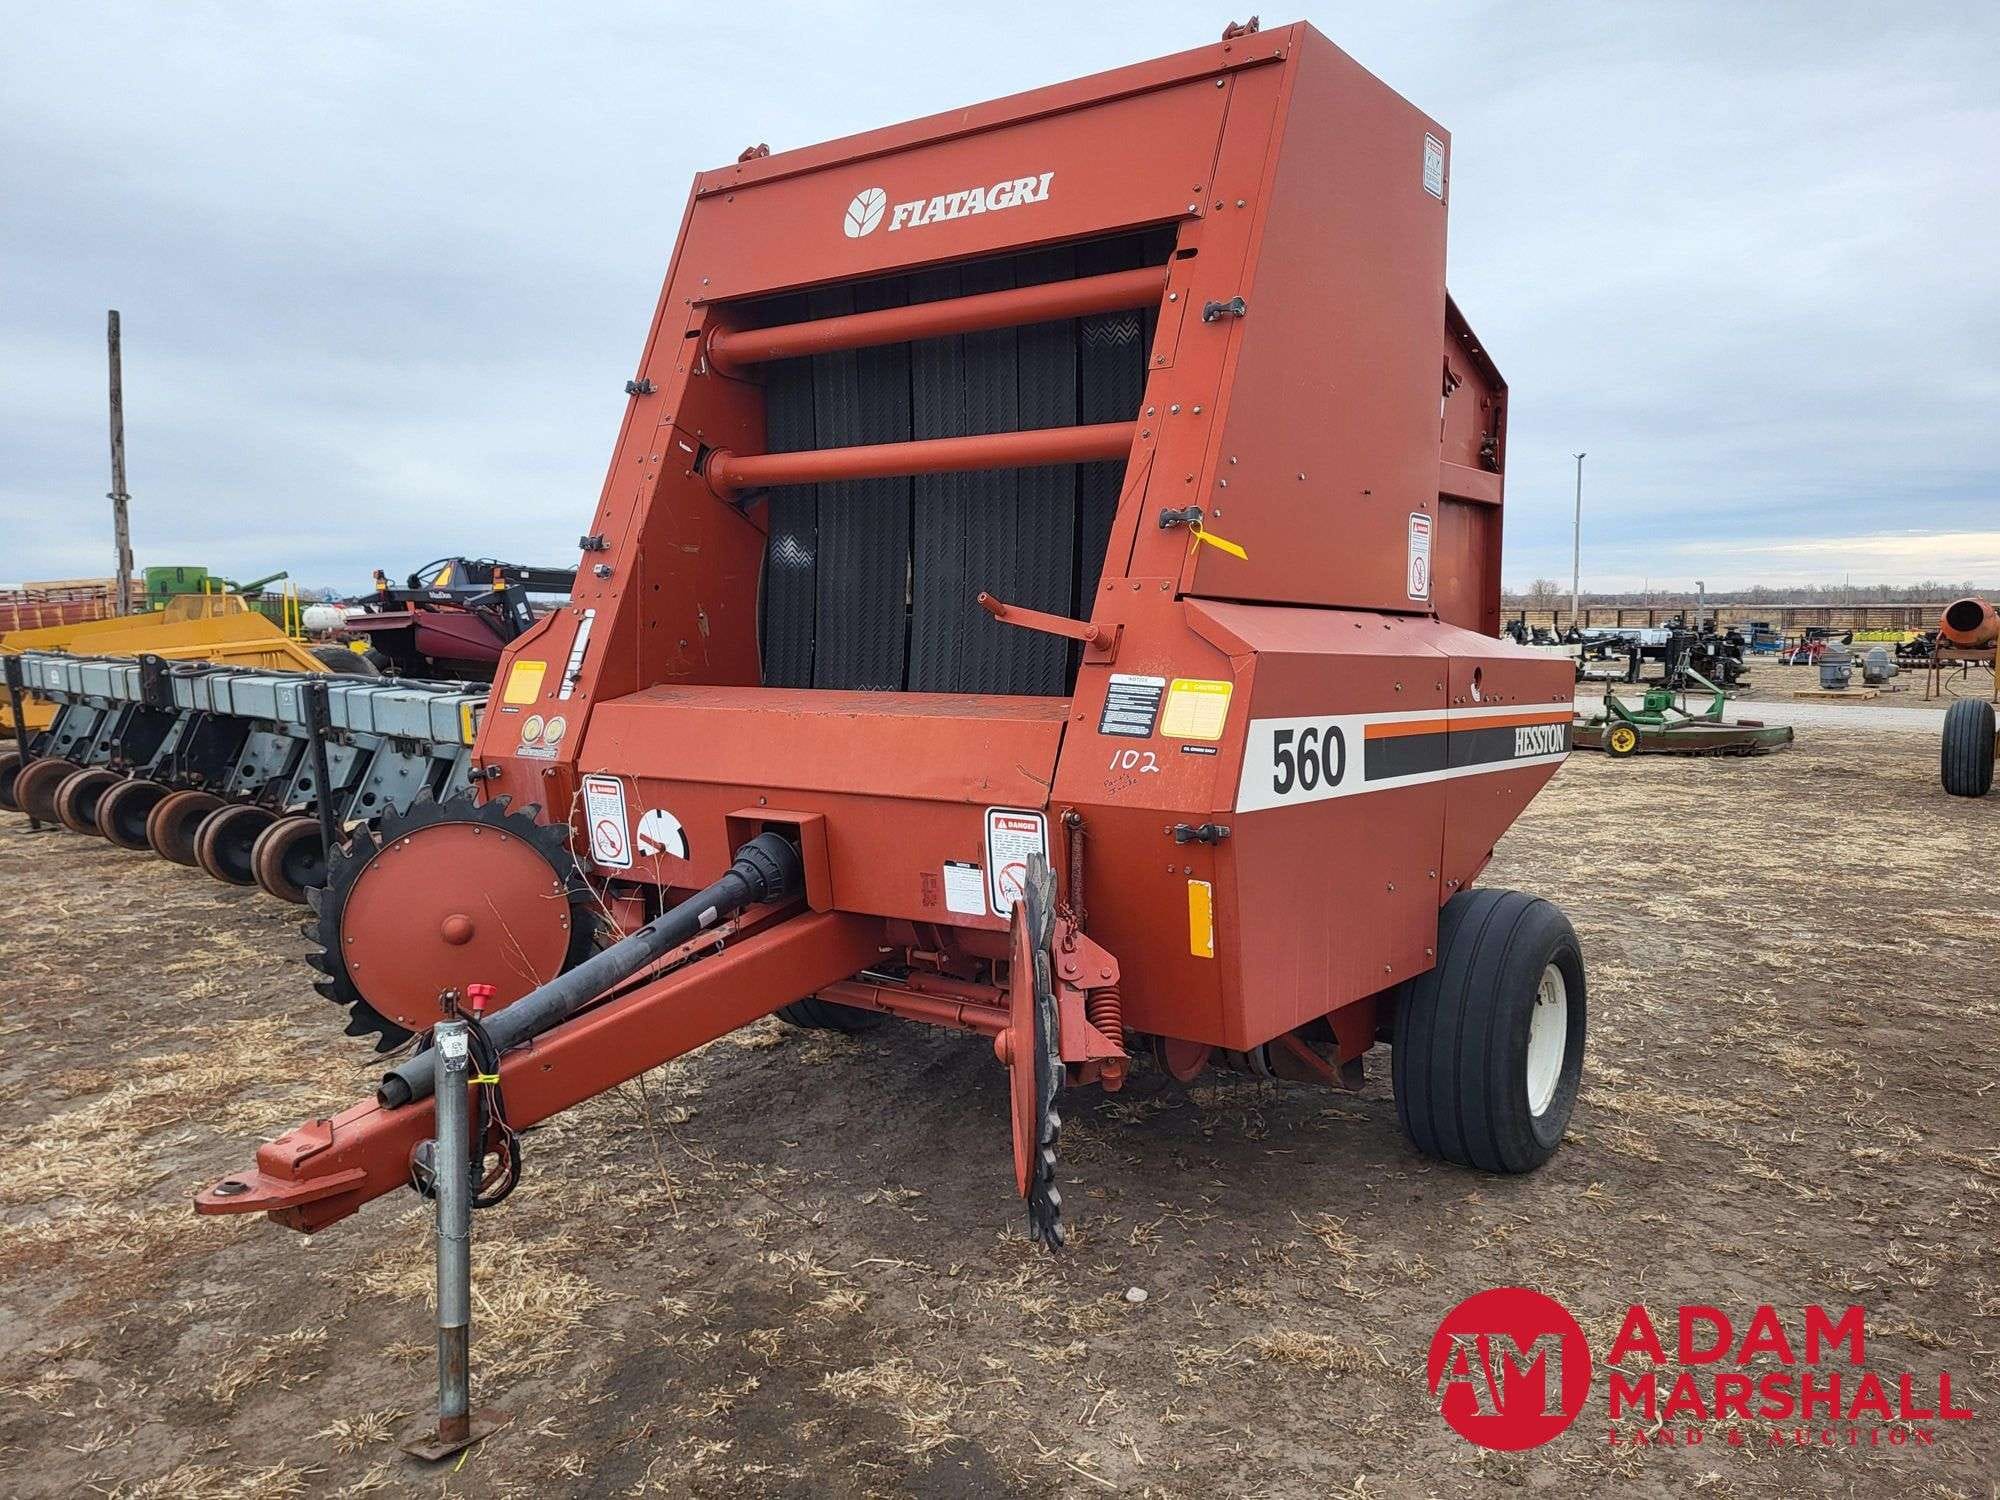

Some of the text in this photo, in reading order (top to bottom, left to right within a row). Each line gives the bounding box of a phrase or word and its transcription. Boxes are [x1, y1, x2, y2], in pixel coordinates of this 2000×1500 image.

[887, 171, 1055, 232] FIATAGRI
[1514, 724, 1565, 757] HESSTON
[1109, 749, 1160, 773] 102
[1273, 725, 1346, 795] 560
[1007, 821, 1036, 831] DANGER
